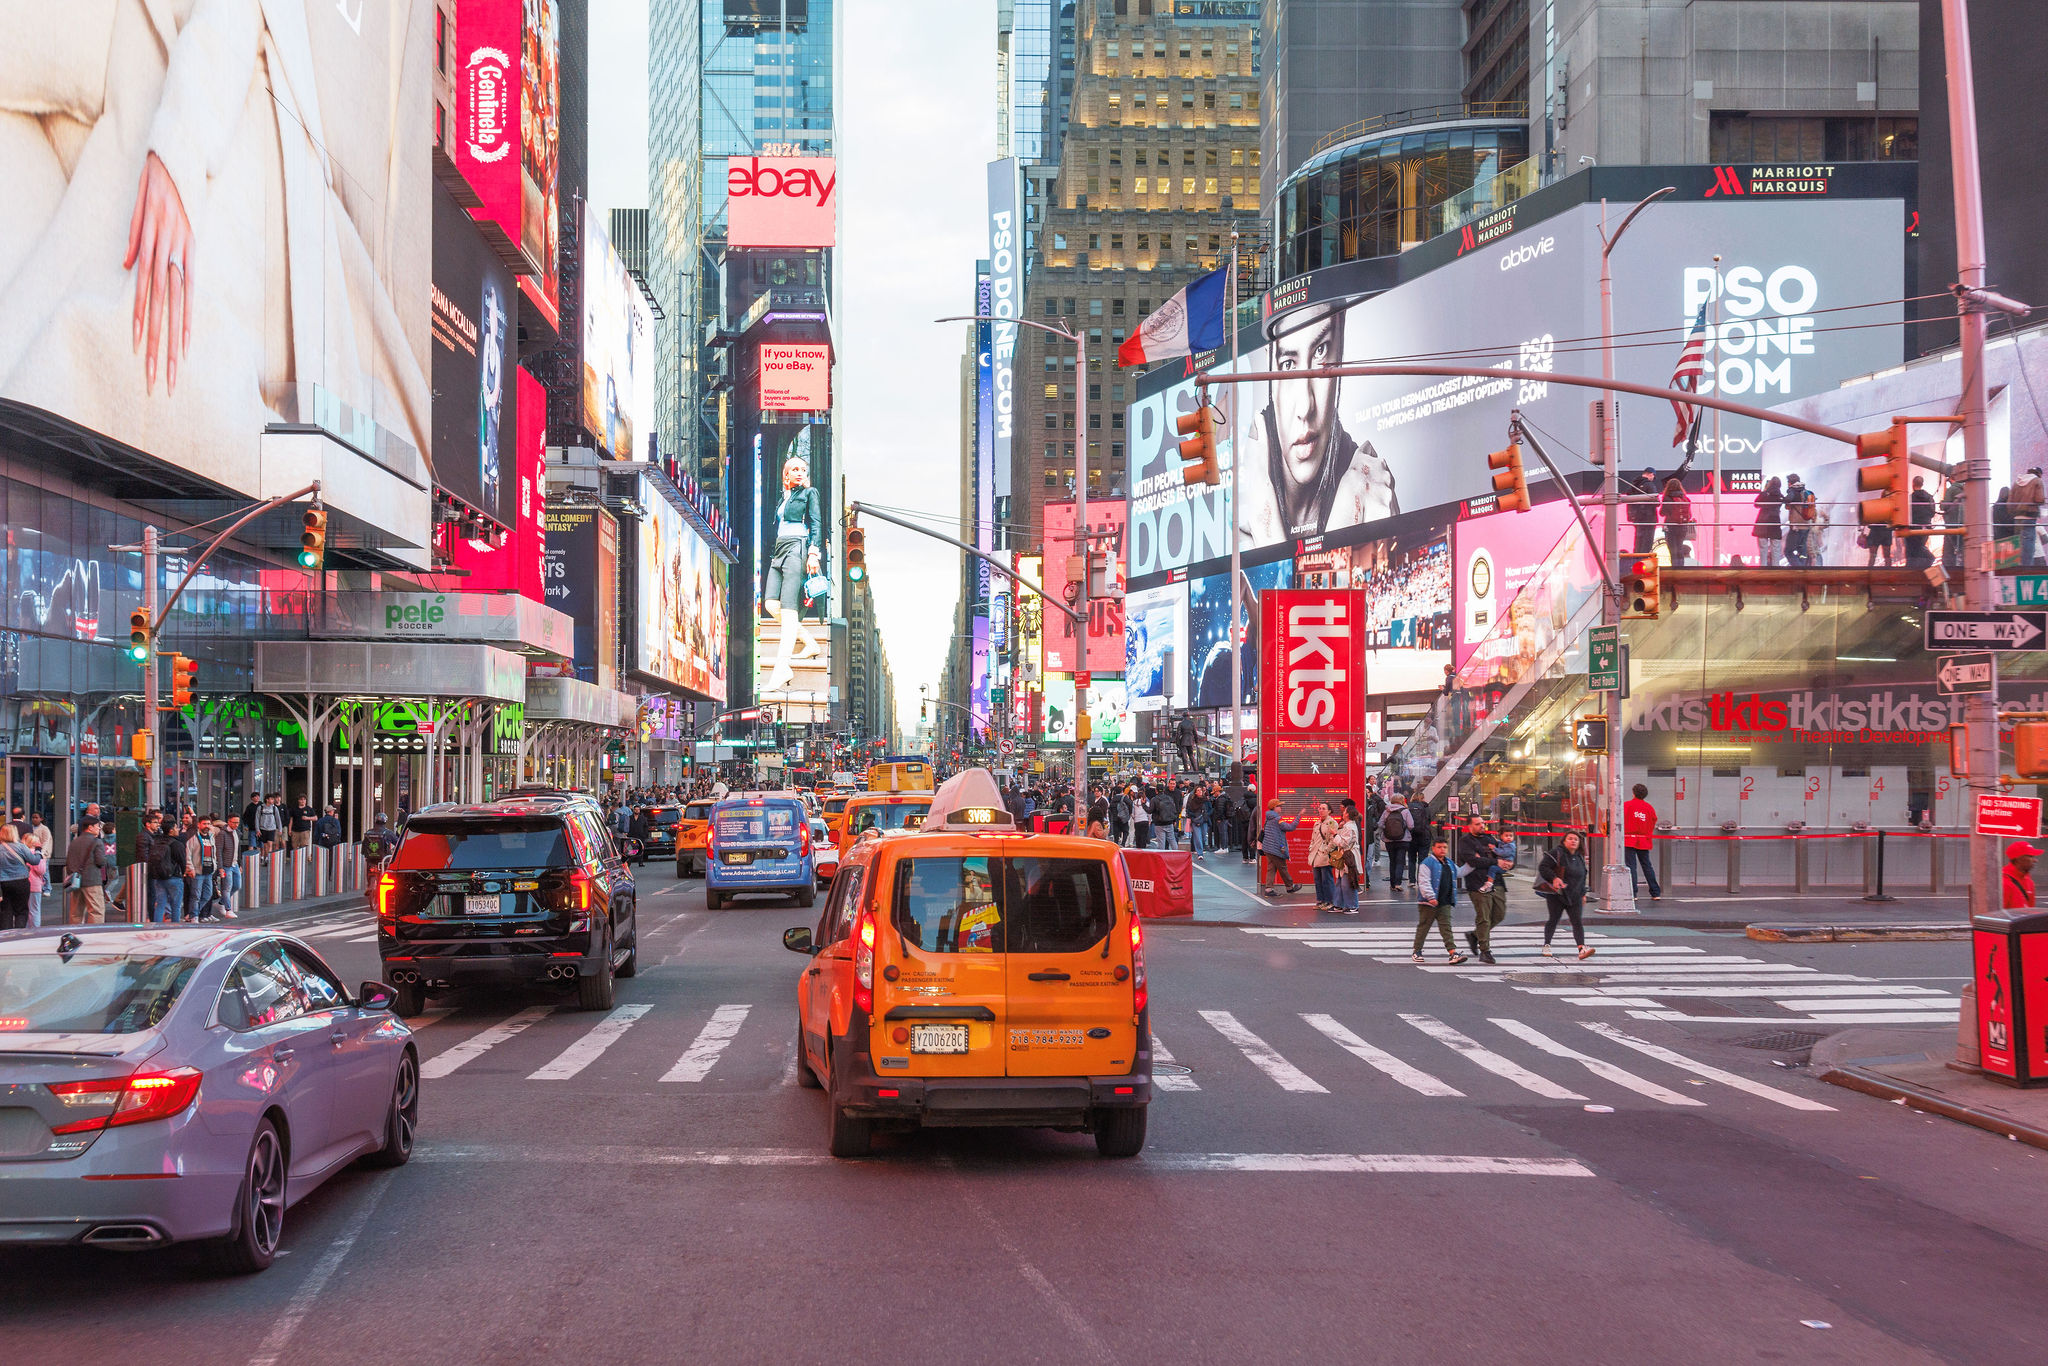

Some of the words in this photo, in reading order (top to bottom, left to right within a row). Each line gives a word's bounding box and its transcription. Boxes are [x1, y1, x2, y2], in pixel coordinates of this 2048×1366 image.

[478, 64, 502, 144] Centinela
[728, 157, 836, 206] ebay
[1752, 166, 1835, 178] MARRIOTT
[1752, 180, 1825, 192] MARQUIS
[1478, 205, 1518, 230] MARRIOTT
[1478, 219, 1514, 243] MARQUIS
[993, 210, 1012, 274] PSO
[1500, 236, 1554, 271] abbvie
[1274, 276, 1313, 298] MARRIOTT
[1683, 265, 1818, 317] PSO
[1274, 290, 1308, 312] MARQUIS
[764, 348, 772, 358] If
[773, 351, 793, 360] you
[795, 349, 825, 360] know,
[1519, 334, 1554, 369] PSO
[764, 363, 783, 372] you
[786, 361, 814, 372] eBay.
[1401, 376, 1462, 409] DERMATOLOGIST
[1415, 403, 1432, 421] AND
[1431, 388, 1475, 415] TREATMENT
[1474, 376, 1513, 401] OPTIONS
[1132, 476, 1153, 499] WITH
[1132, 486, 1176, 517] PSORIASIS
[1470, 495, 1497, 507] MARRIOTT
[1470, 504, 1494, 516] MARQUIS
[560, 514, 592, 523] COMEDY!
[2020, 580, 2034, 601] W
[385, 595, 446, 629] pelé
[1944, 623, 1979, 638] ONE
[1993, 624, 2029, 638] WAY
[1287, 600, 1350, 729] tkts
[1628, 692, 1708, 732] tkts
[1708, 691, 1788, 732] tkts
[1737, 734, 1771, 743] service
[1773, 734, 1783, 743] of
[1789, 728, 1854, 744] Theatre
[1860, 727, 1951, 748] Developme
[1679, 776, 1686, 791] 1
[1743, 776, 1755, 792] 2
[1808, 776, 1821, 792] 3
[1873, 776, 1885, 792] 4
[1938, 776, 1950, 791] 5
[1993, 800, 2033, 809] STANDING
[968, 809, 991, 823] 3V86
[916, 1032, 963, 1047] Y200628C
[1010, 1035, 1084, 1044] 718-784-9292
